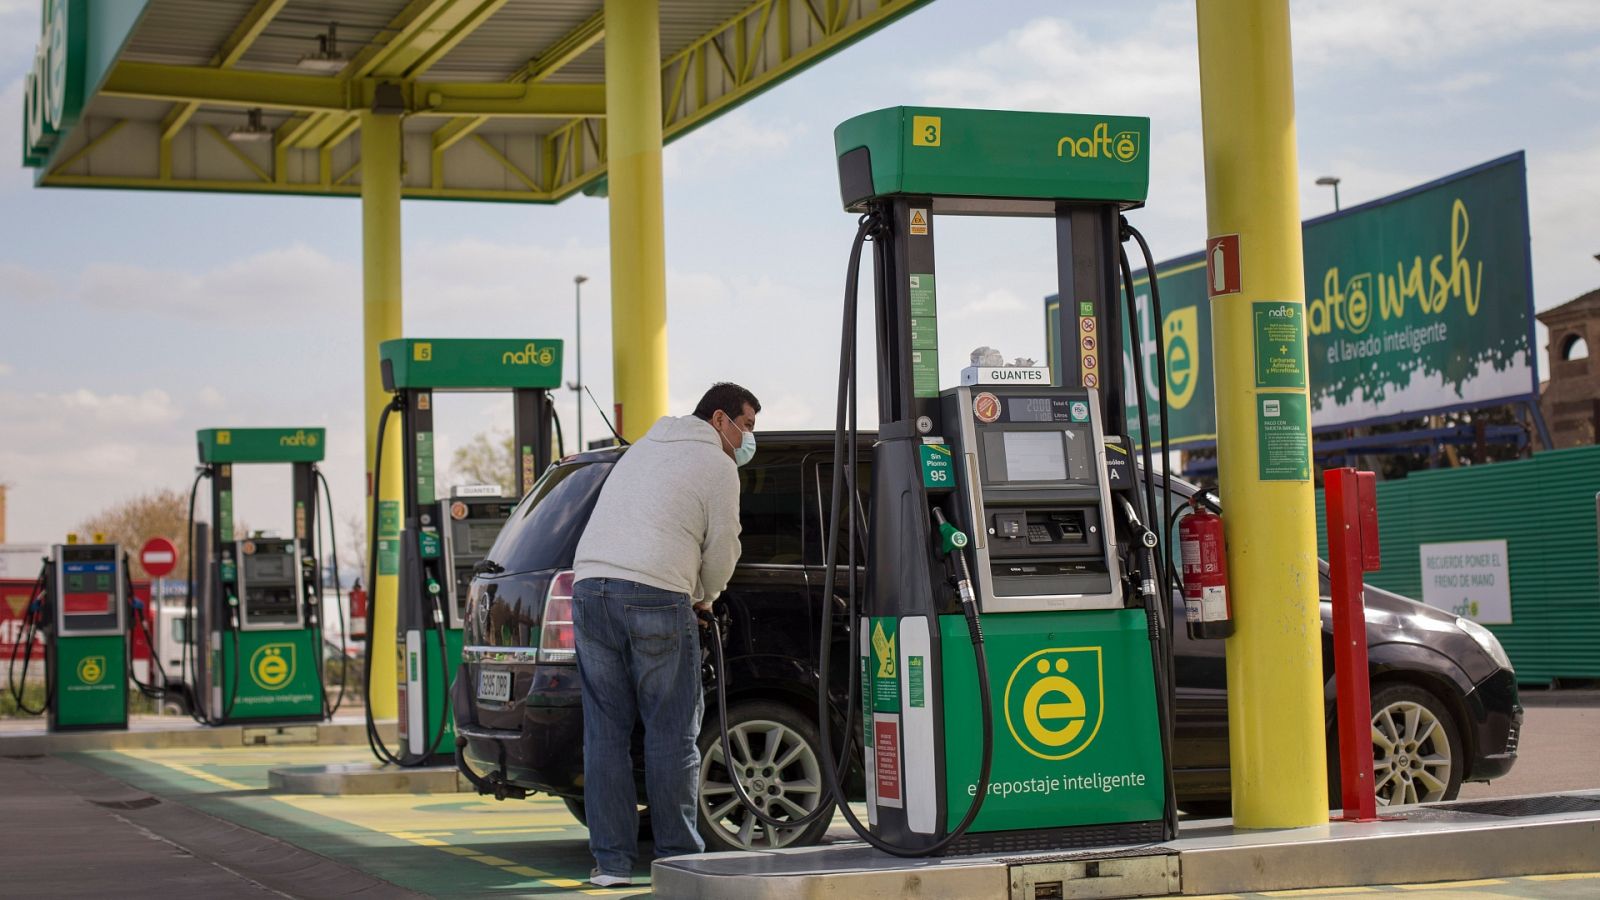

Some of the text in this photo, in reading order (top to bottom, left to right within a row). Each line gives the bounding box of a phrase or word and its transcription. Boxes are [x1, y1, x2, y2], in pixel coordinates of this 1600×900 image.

[924, 125, 937, 144] 3
[1057, 122, 1140, 163] naftë
[1307, 198, 1484, 336] aftë wash
[1327, 321, 1448, 364] el lavado inteligente
[421, 348, 429, 359] 5
[991, 370, 1042, 380] GUANTES
[930, 470, 947, 481] 95
[1110, 468, 1120, 480] A
[1426, 553, 1501, 570] RECUERDE PONER EL
[1434, 573, 1495, 588] FRENO DE MANO
[986, 776, 1060, 799] repostaje
[1063, 771, 1146, 793] inteligente
